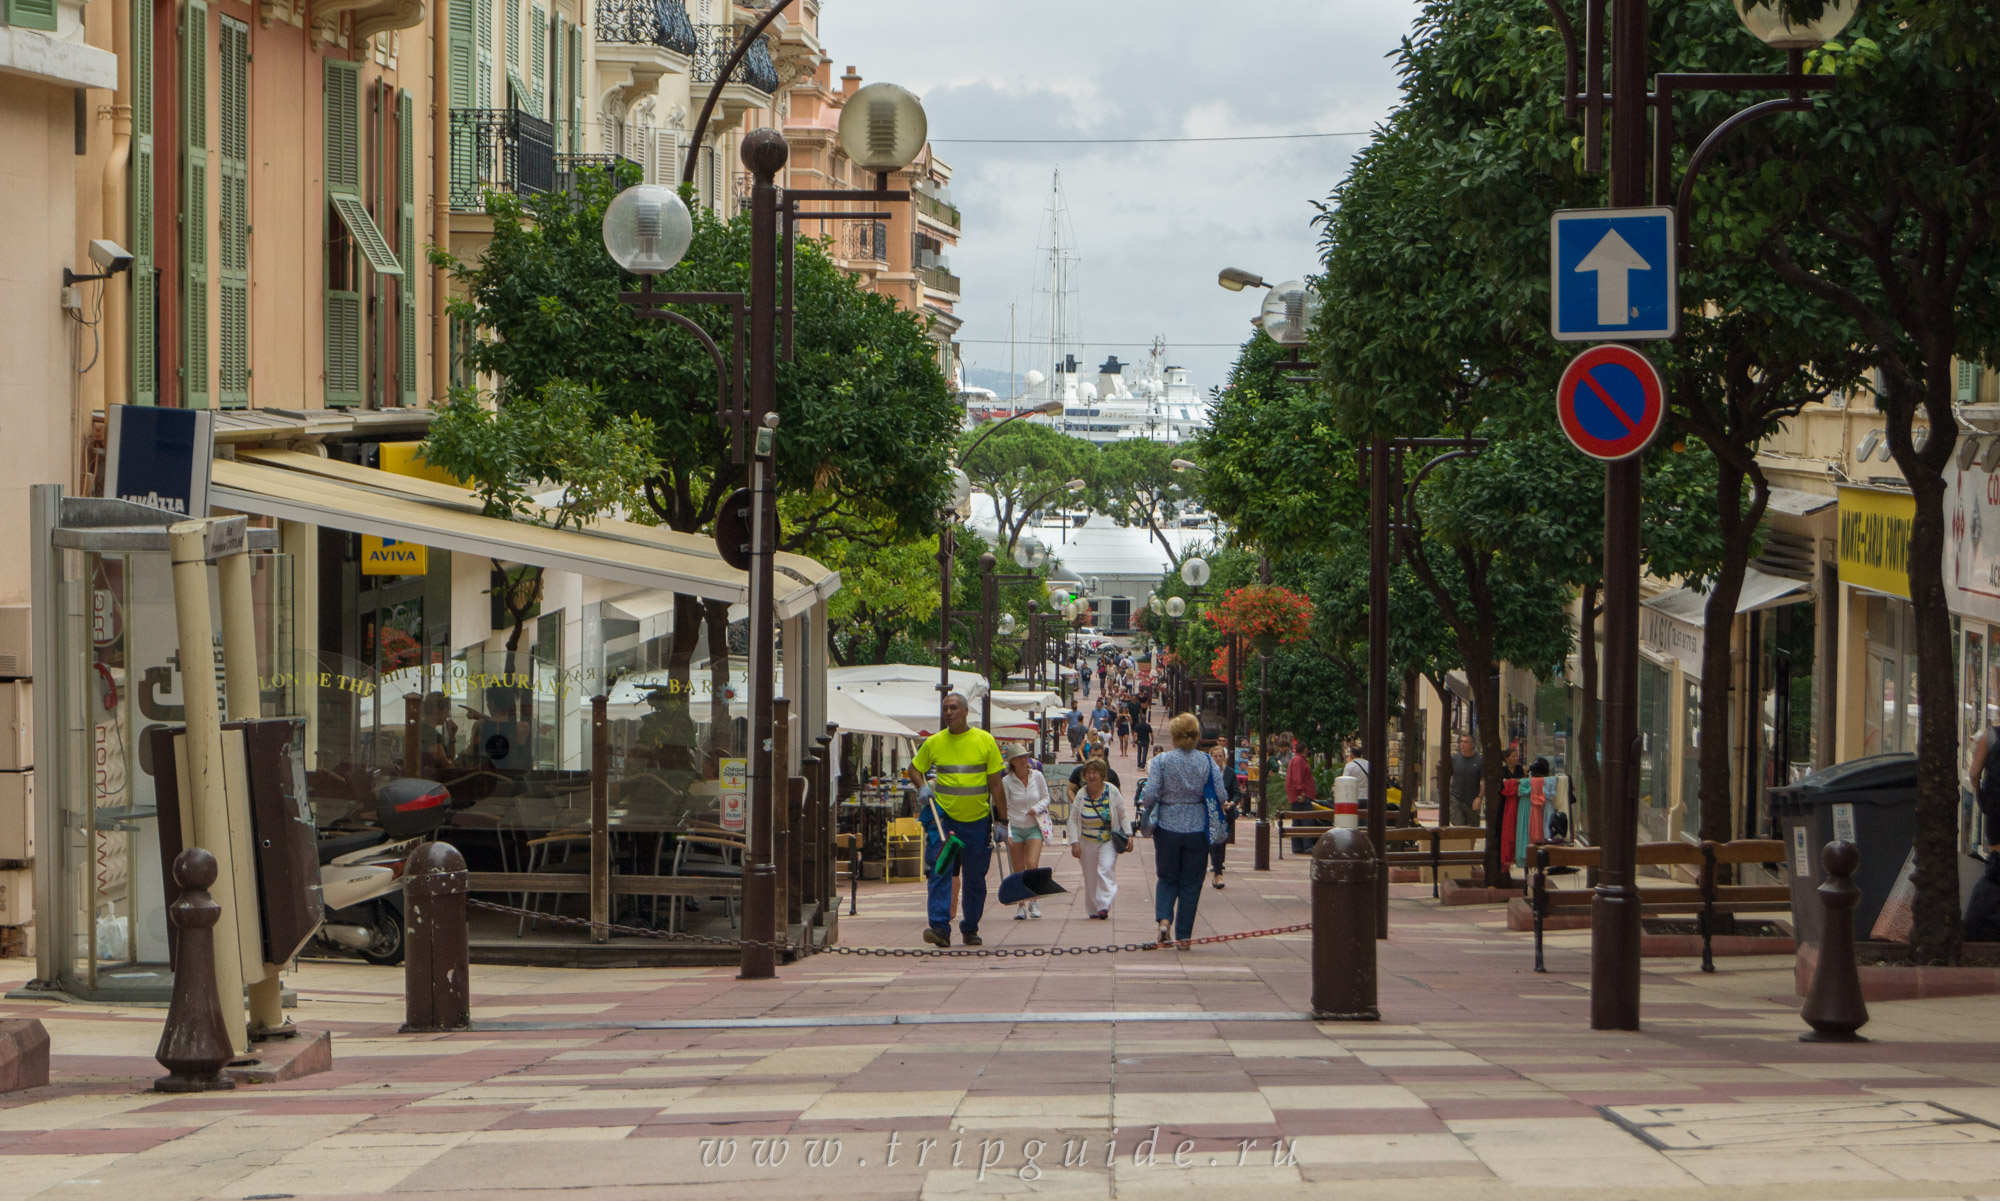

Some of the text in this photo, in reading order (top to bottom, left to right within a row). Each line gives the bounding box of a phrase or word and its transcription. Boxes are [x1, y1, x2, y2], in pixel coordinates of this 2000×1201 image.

[369, 550, 416, 561] AVIVA
[441, 673, 574, 699] RESTAURANT
[669, 678, 713, 694] BAR
